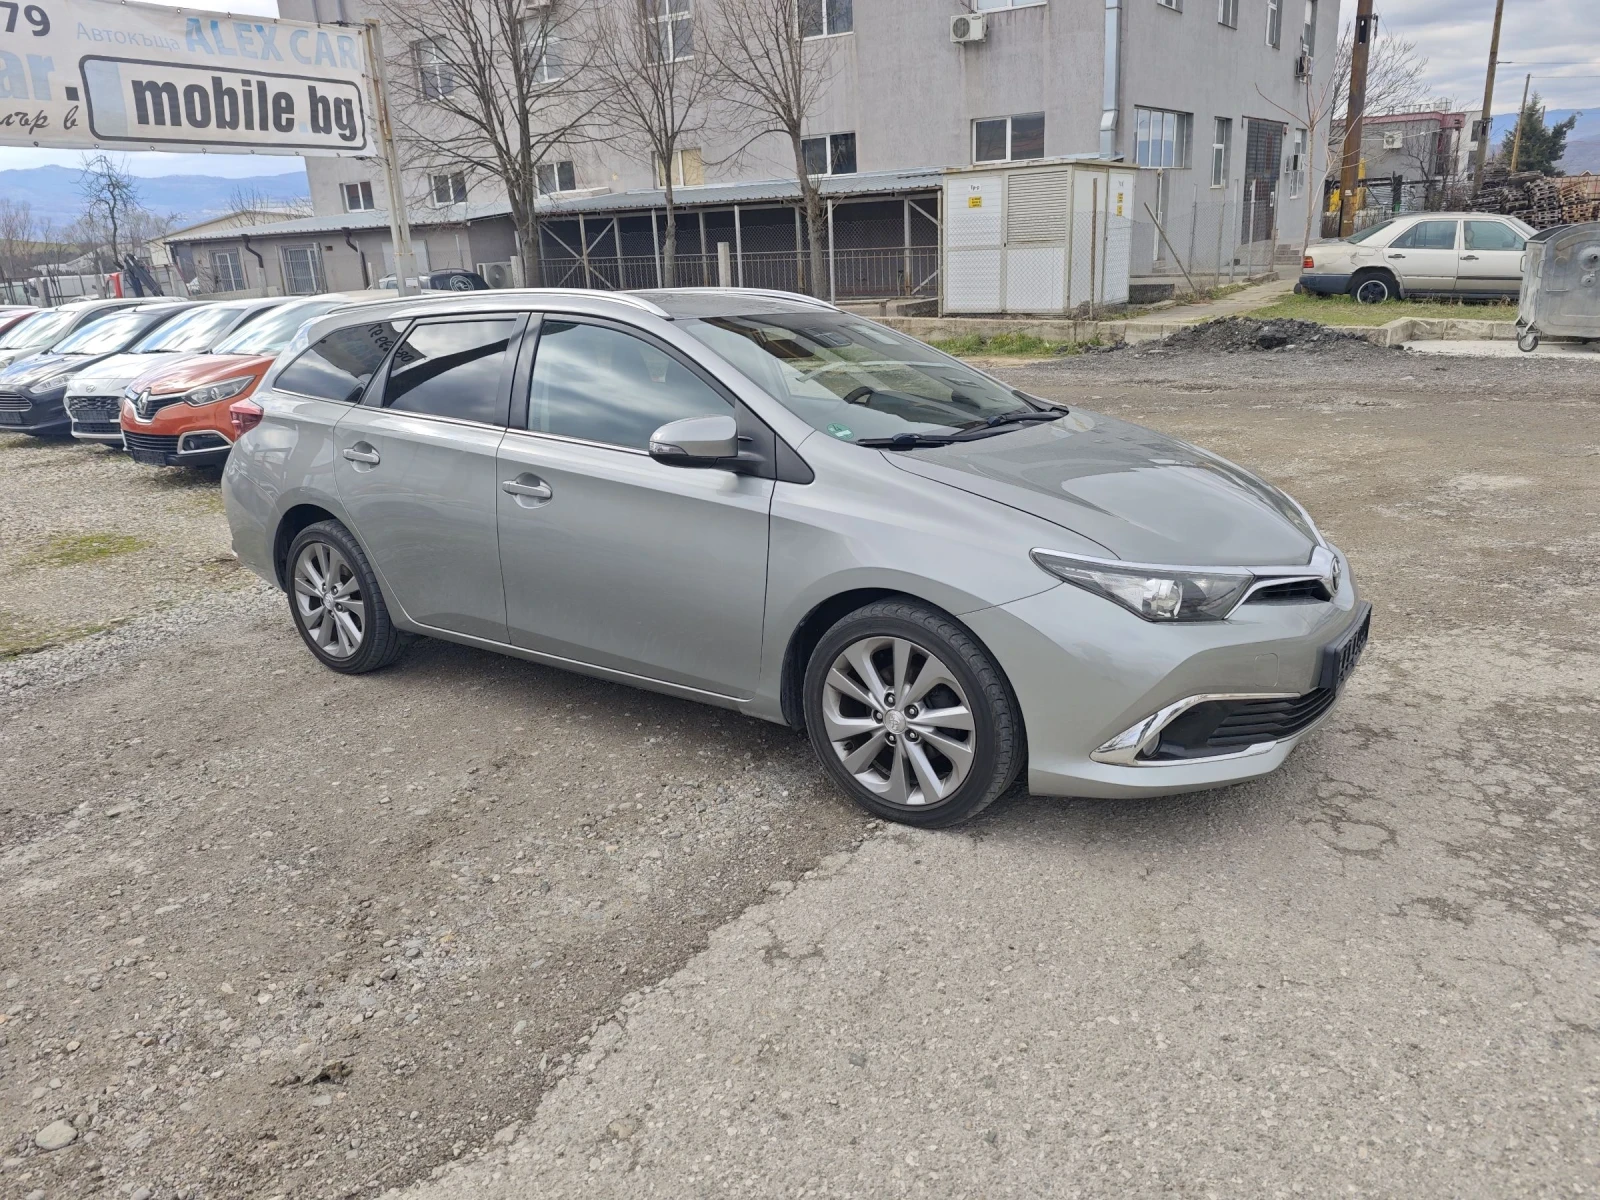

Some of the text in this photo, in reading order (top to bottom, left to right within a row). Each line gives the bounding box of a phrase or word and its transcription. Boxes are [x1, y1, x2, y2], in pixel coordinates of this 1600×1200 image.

[0, 1, 50, 37] 79
[76, 22, 181, 52] Автокъща
[185, 17, 358, 70] ALEX CAR
[131, 76, 357, 141] mobile.bg
